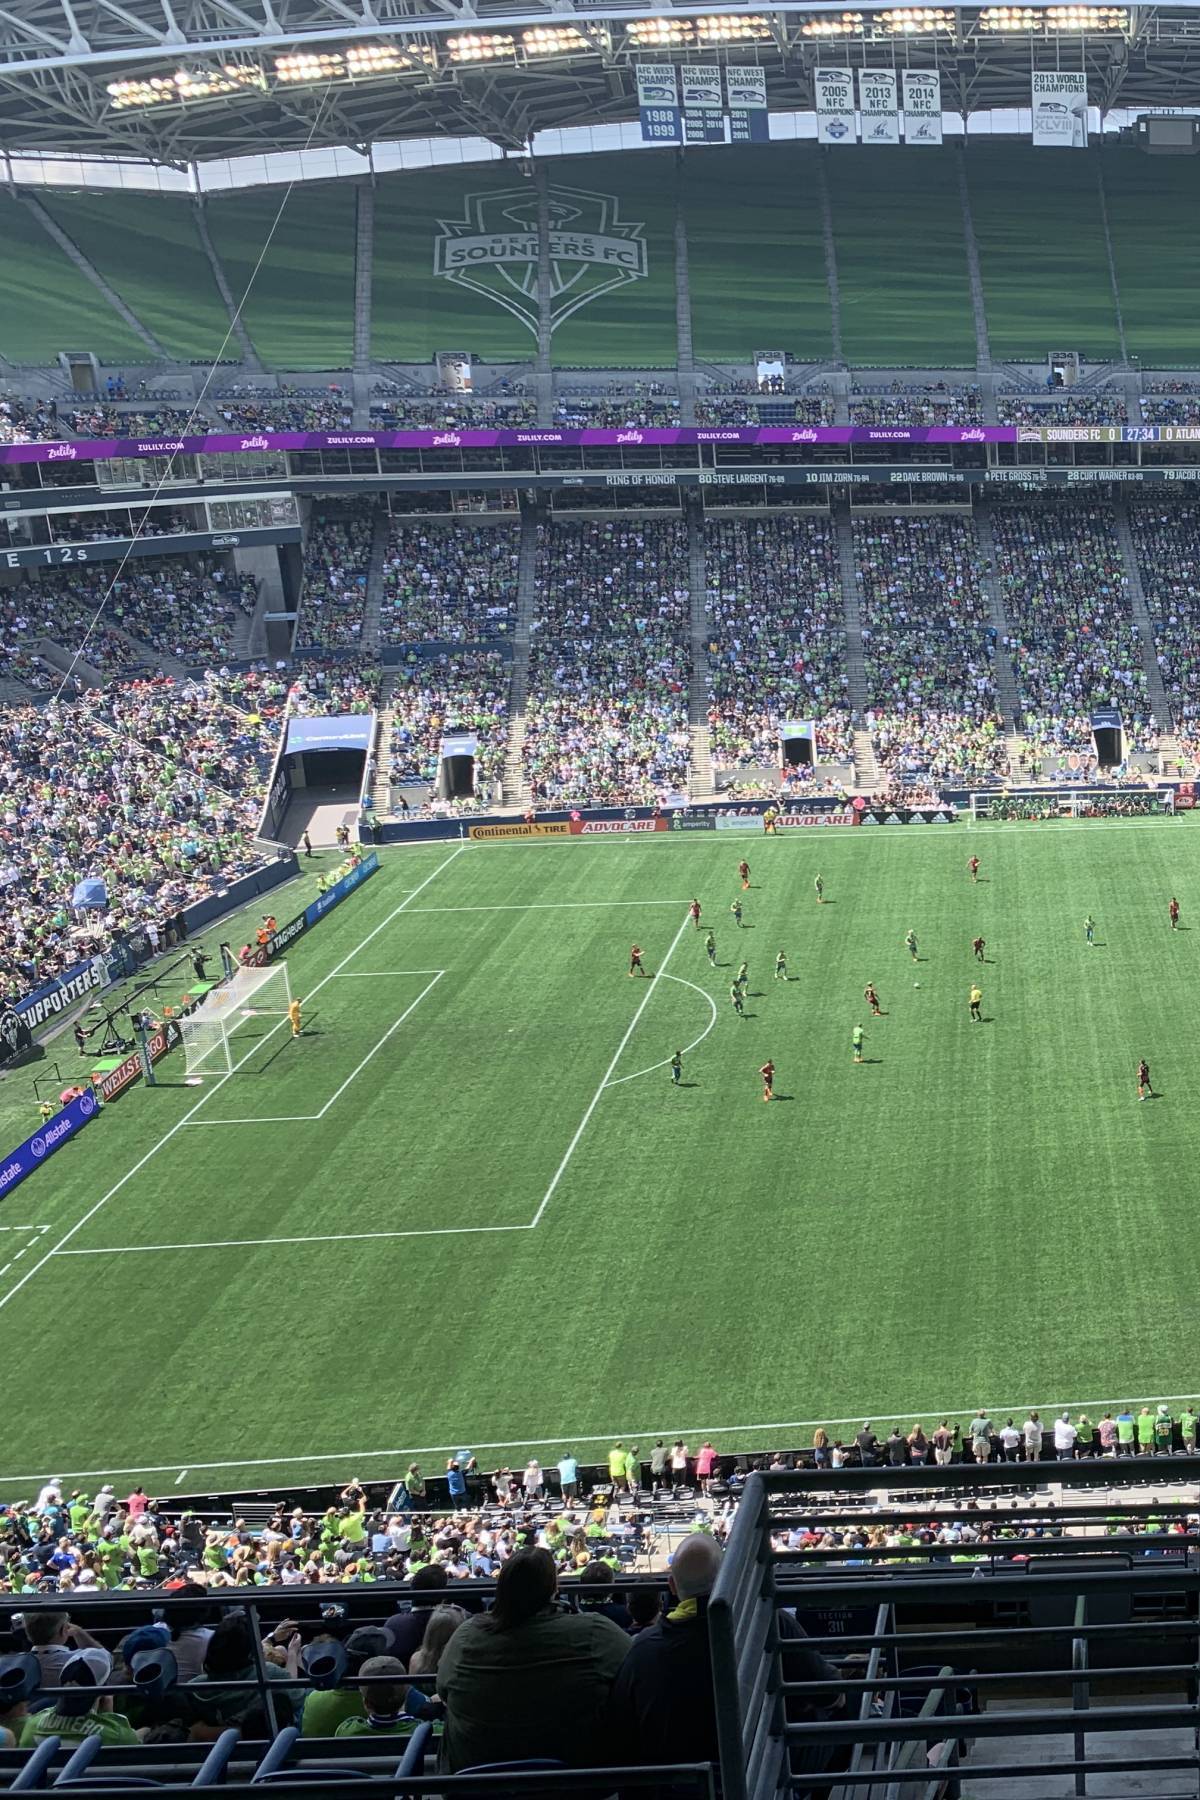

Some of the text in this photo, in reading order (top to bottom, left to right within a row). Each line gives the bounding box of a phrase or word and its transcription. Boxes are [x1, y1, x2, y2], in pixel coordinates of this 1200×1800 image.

[654, 67, 674, 75] WEST
[682, 67, 719, 76] NFC WEST
[744, 69, 764, 77] WEST
[638, 76, 675, 85] CHAMPS
[683, 76, 720, 86] CHAMPS
[728, 77, 764, 87] CHAMPS
[1034, 74, 1085, 84] 2013 WORLD
[822, 86, 847, 97] 2005
[865, 87, 891, 98] 2013
[908, 88, 934, 99] 2014
[1034, 84, 1085, 93] CHAMPIONS
[826, 98, 845, 107] NFC
[870, 100, 888, 108] NFC
[913, 100, 931, 109] NFC
[646, 110, 674, 122] 1988
[648, 124, 675, 136] 1999
[491, 236, 593, 244] SEATLE
[603, 248, 634, 264] FC
[1047, 429, 1089, 440] SOUNDERS
[1091, 429, 1100, 440] FC
[1127, 429, 1154, 440] 27:34
[1166, 428, 1172, 440] 0
[138, 443, 184, 451] ZULILY.COM
[606, 474, 676, 484] RING OF HONOR
[699, 474, 768, 484] 80 STEVE LARGENT
[806, 473, 853, 482] 10 JIM ZORN
[890, 472, 948, 481] 22 DAVE BROWN
[991, 472, 1032, 480] PETE GROSS
[1068, 472, 1127, 480] 28 CURT WARNER
[1163, 471, 1175, 480] 79
[1175, 471, 1196, 479] JACOB
[774, 814, 853, 827] ADVOCARE
[472, 825, 567, 839] Continental TIRE
[581, 820, 655, 834] ADVOCARE
[102, 1060, 134, 1096] WELLS
[44, 1118, 72, 1148] Allstate
[828, 1621, 845, 1632] 311
